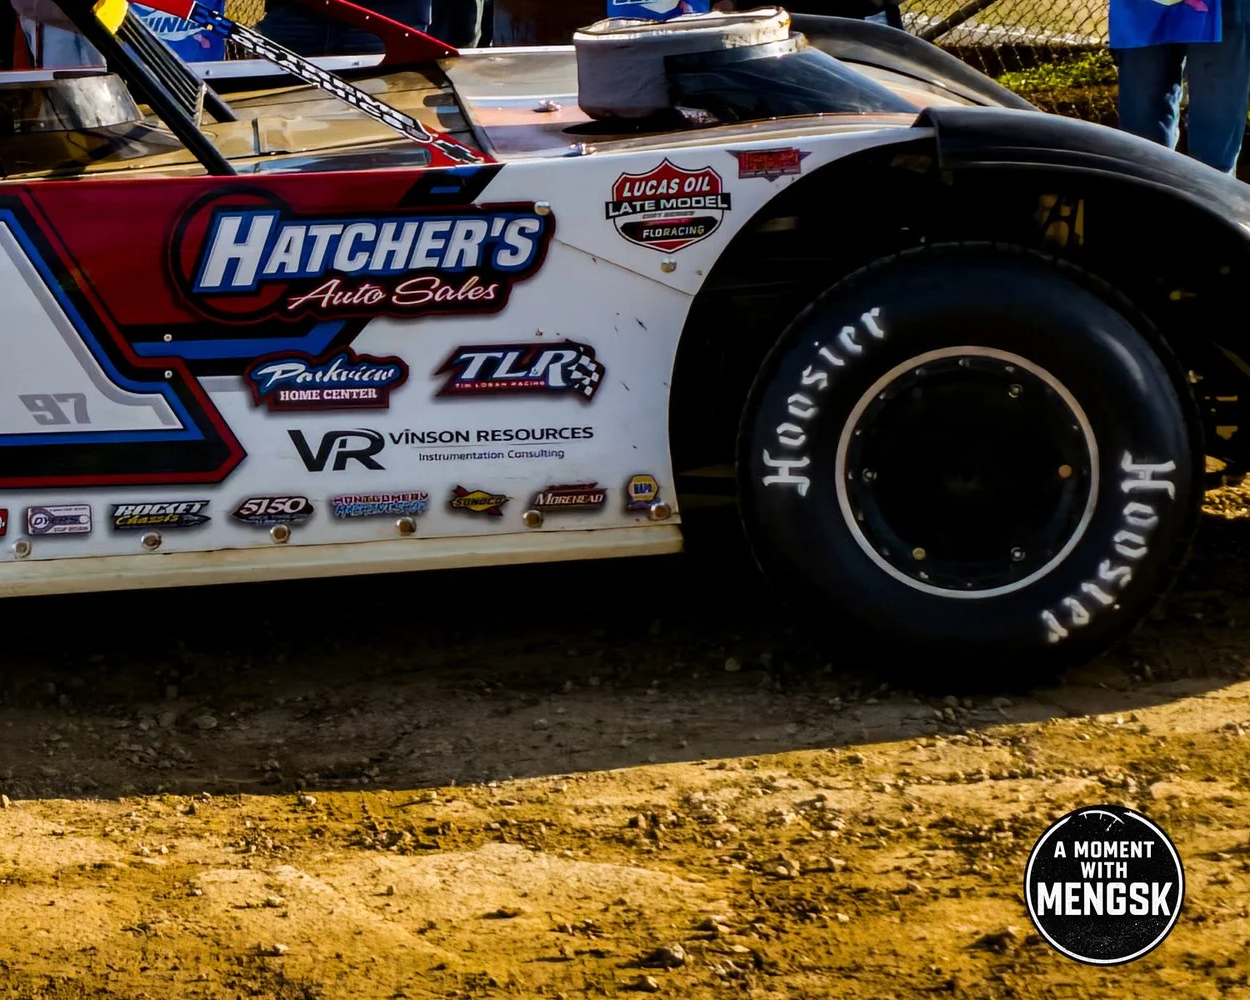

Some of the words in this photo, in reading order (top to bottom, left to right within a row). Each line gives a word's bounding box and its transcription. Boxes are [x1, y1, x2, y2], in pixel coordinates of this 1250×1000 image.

[623, 177, 680, 198] LUCAS
[683, 173, 711, 192] OIL
[608, 200, 656, 217] LATE
[660, 195, 729, 210] MODEL
[198, 213, 542, 289] HATCHER'S
[287, 277, 387, 311] Auto
[392, 274, 500, 306] Sales
[256, 357, 395, 389] Parkview
[457, 348, 580, 388] TLR
[279, 389, 322, 402] HOME
[323, 388, 379, 401] CENTER
[762, 306, 886, 498] Hoosier
[18, 393, 92, 426] 97
[476, 426, 594, 442] RESOURCES
[418, 450, 505, 462] Instrumentation
[507, 448, 565, 462] Consulting
[114, 501, 209, 516] ROCKET
[239, 497, 308, 515] 5150
[1040, 450, 1177, 644] Hoosier
